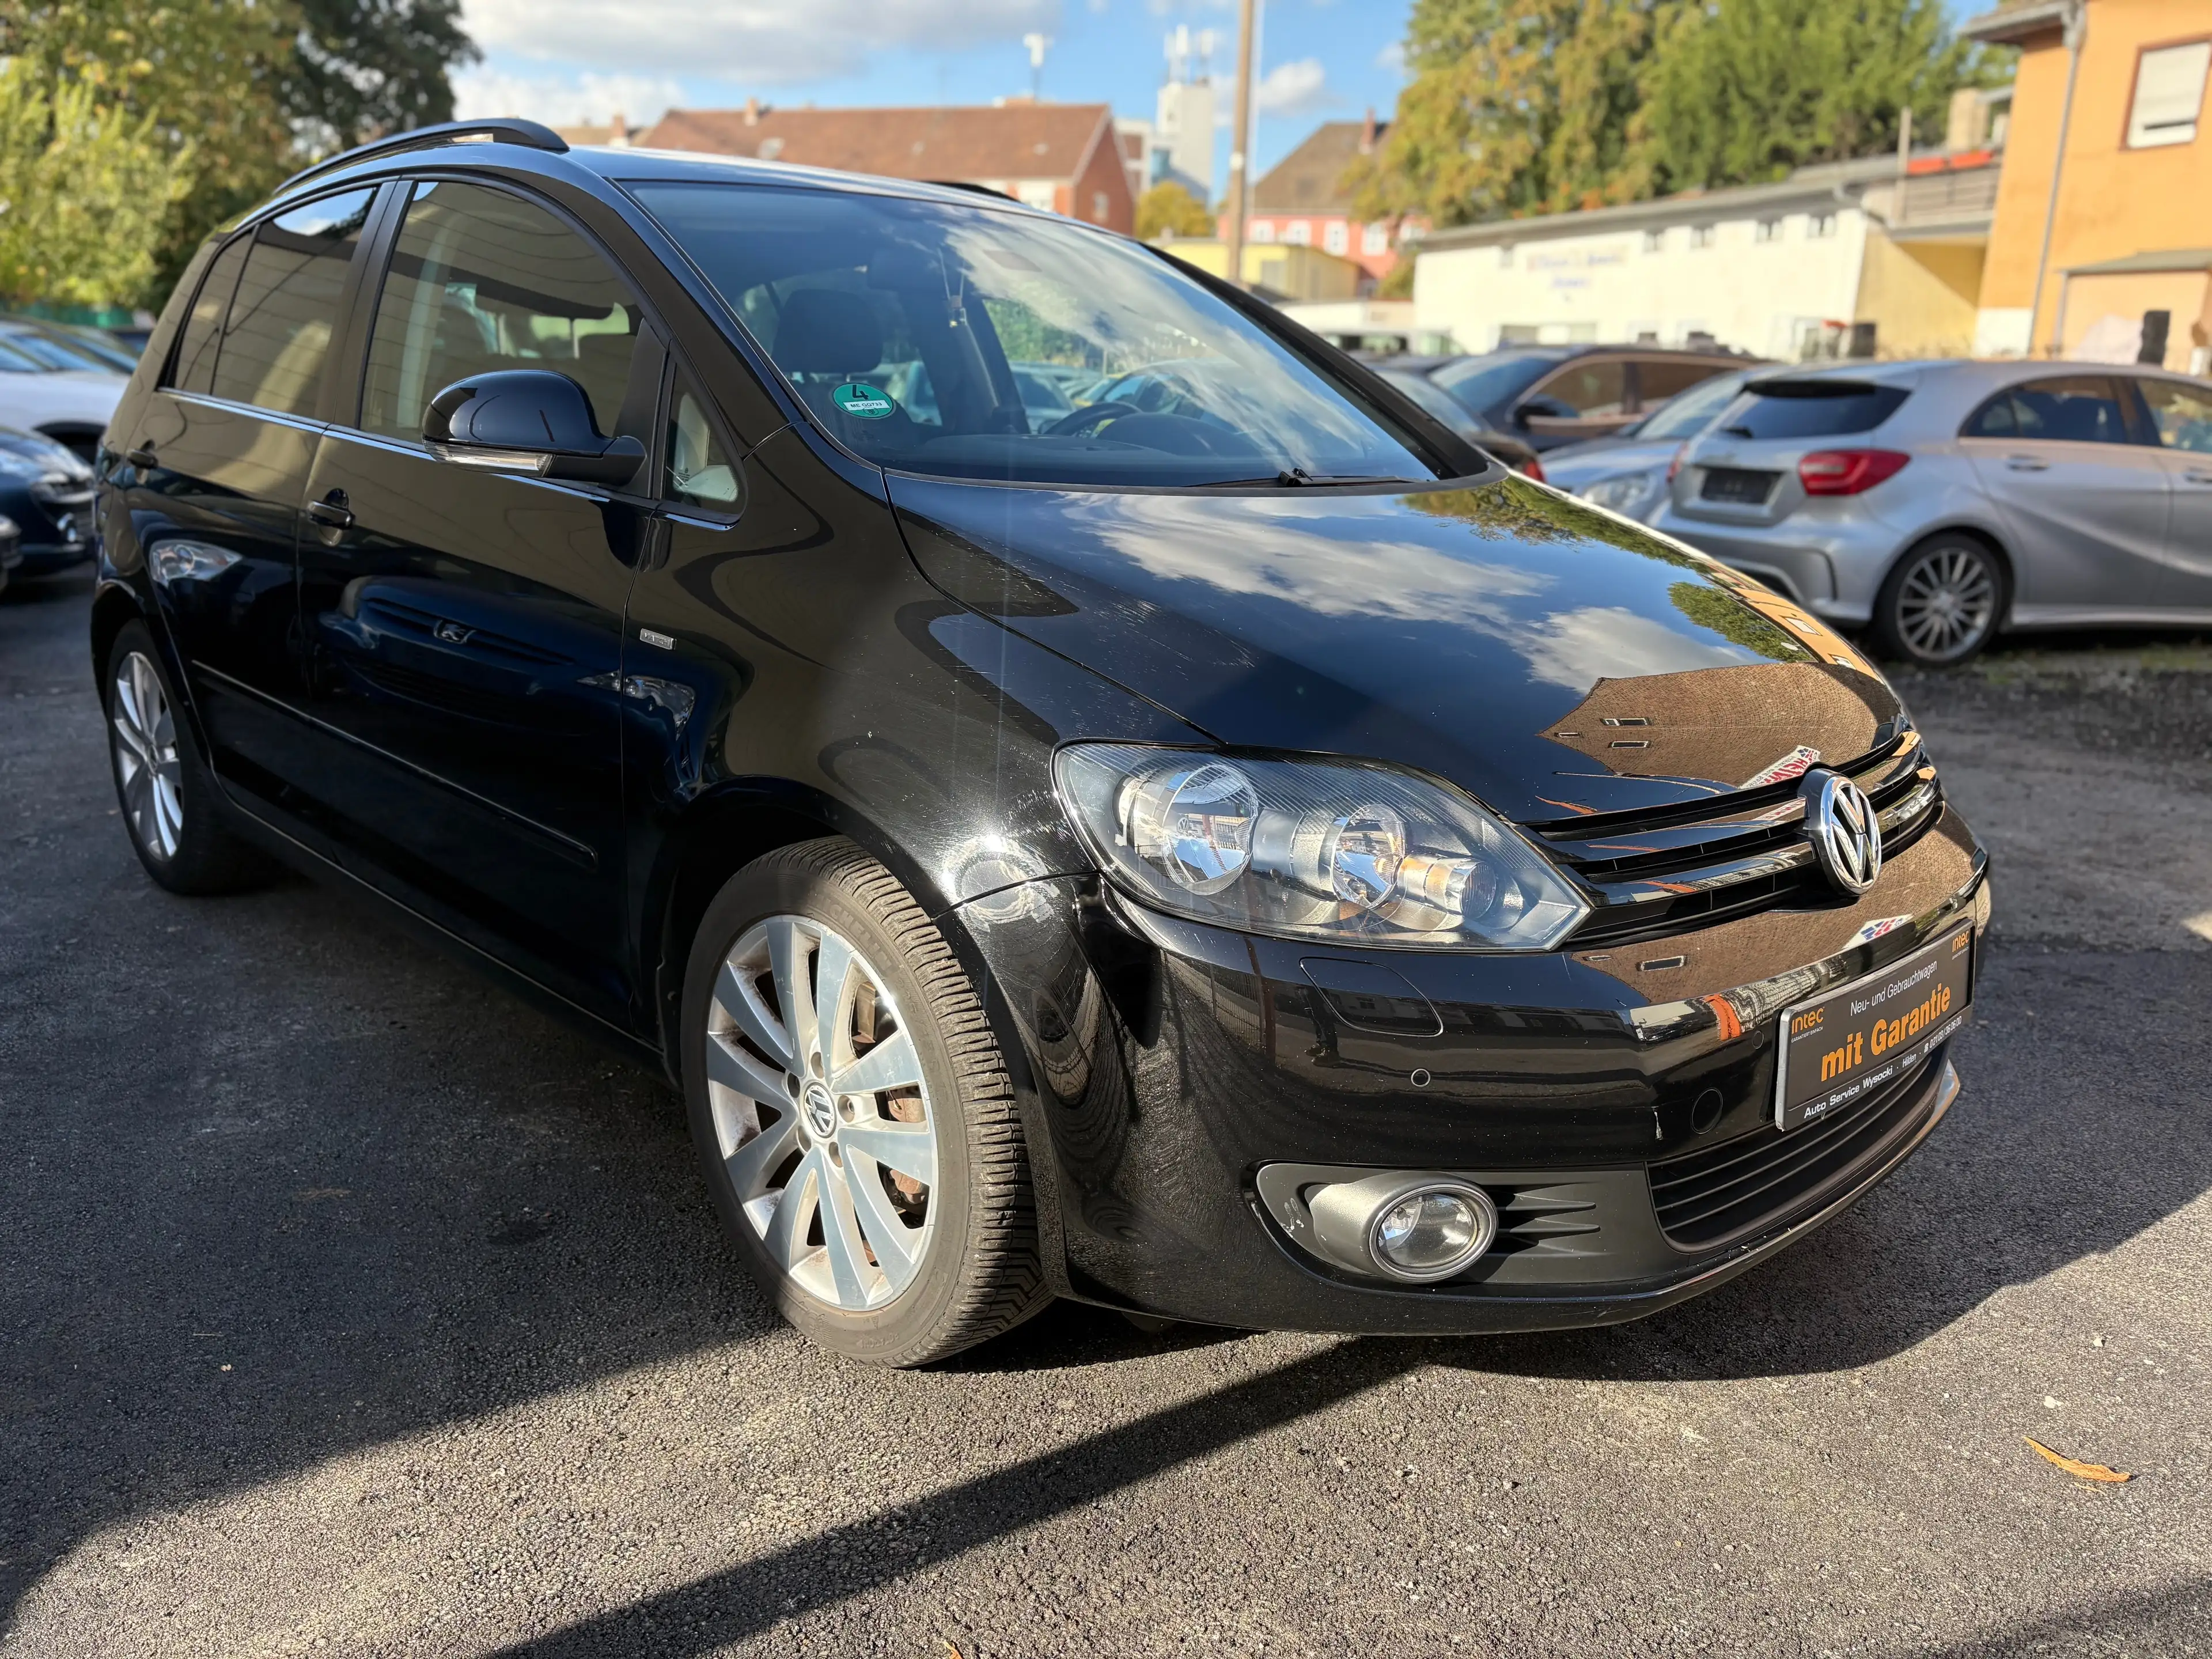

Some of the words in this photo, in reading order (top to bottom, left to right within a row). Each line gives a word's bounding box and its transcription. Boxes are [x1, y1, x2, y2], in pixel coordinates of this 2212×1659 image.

[853, 385, 869, 400] 4
[1850, 1000, 1870, 1016] Neu-
[1872, 987, 1885, 1006] und
[1887, 960, 1937, 998] Gebrauchtwagen
[1821, 1032, 1863, 1082] mit
[1871, 983, 1950, 1056] Garantie
[1804, 1101, 1826, 1119] Auto
[1830, 1084, 1860, 1107] Service
[1862, 1066, 1893, 1088] Wysocki
[1902, 1052, 1916, 1068] Hilden
